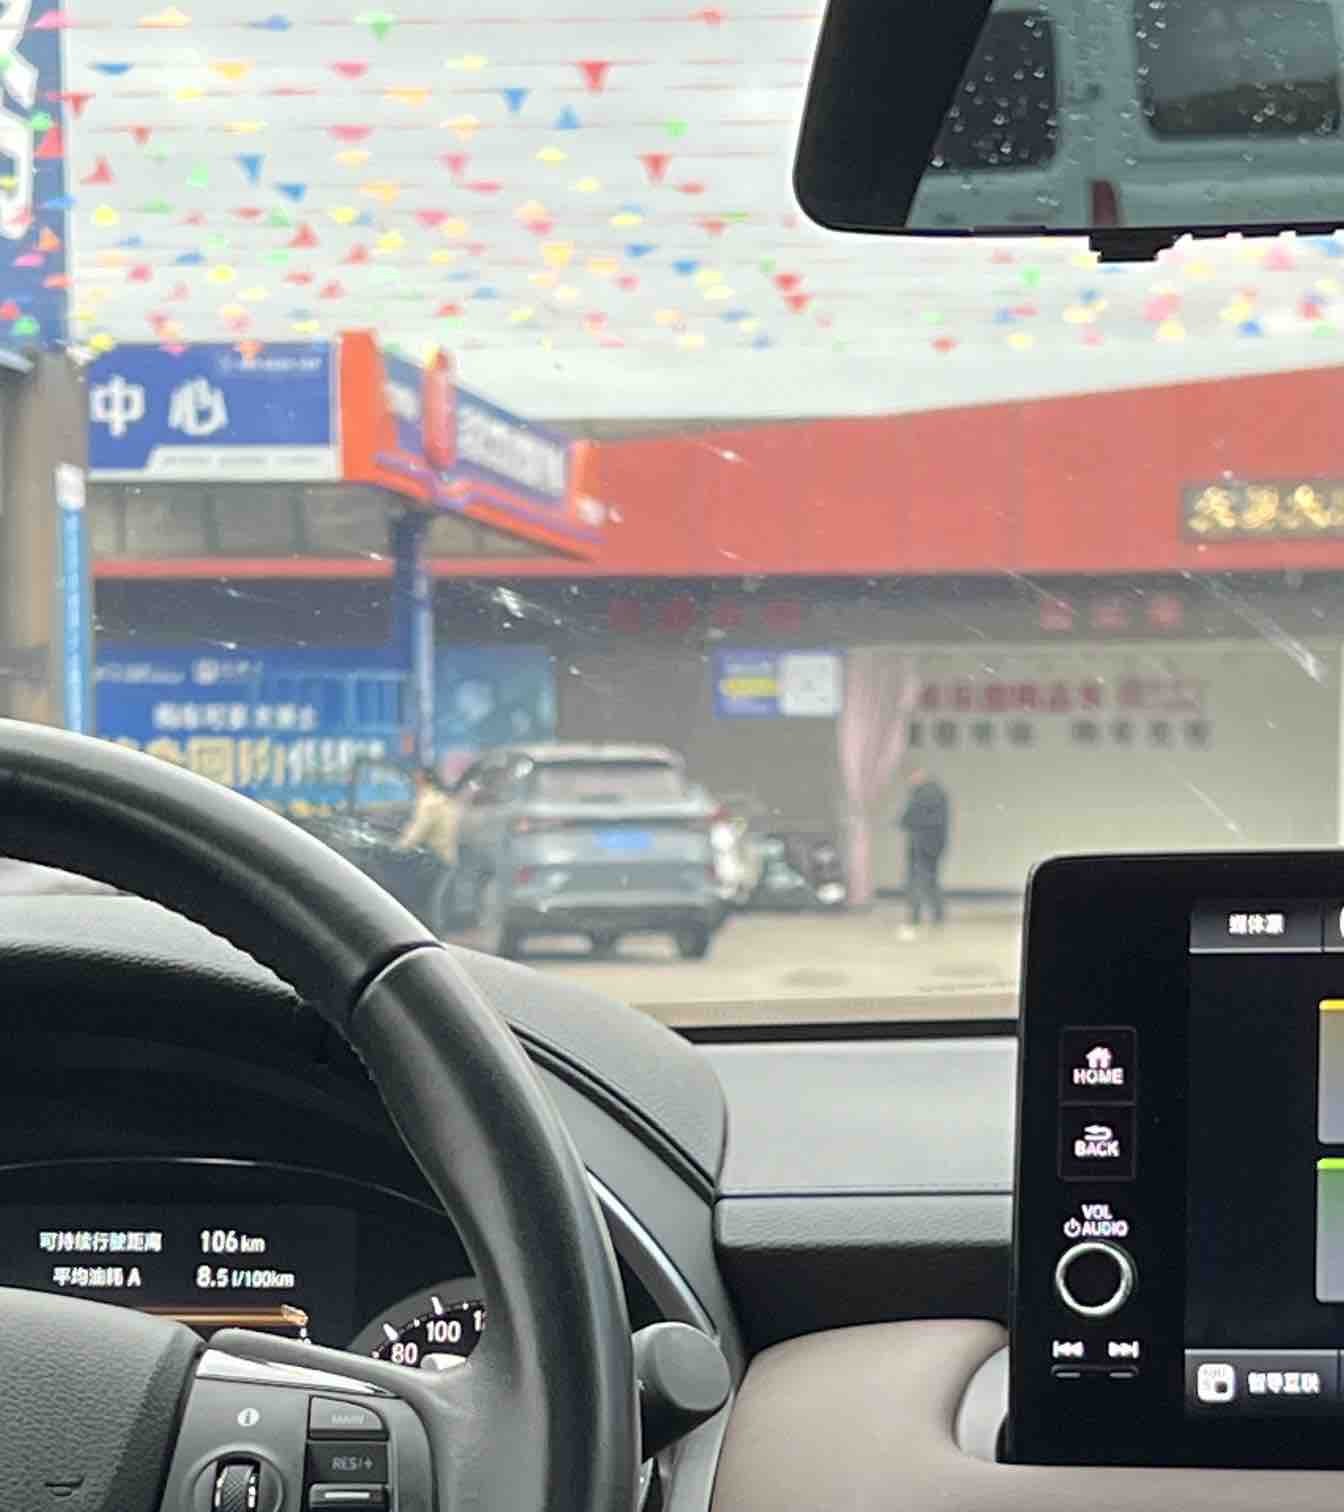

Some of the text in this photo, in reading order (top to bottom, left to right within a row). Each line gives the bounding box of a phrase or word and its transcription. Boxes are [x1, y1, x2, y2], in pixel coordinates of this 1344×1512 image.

[90, 374, 229, 437] 中心
[1072, 1068, 1124, 1085] HOME
[1073, 1140, 1121, 1158] BACK
[1081, 1204, 1114, 1220] VOL
[1082, 1221, 1129, 1238] AUDIO
[200, 1230, 239, 1253] 106
[240, 1236, 266, 1253] km
[52, 1266, 124, 1287] 平均油耗
[126, 1267, 142, 1287] A
[196, 1265, 229, 1288] 8.5
[426, 1319, 462, 1343] 100
[390, 1341, 419, 1365] 80
